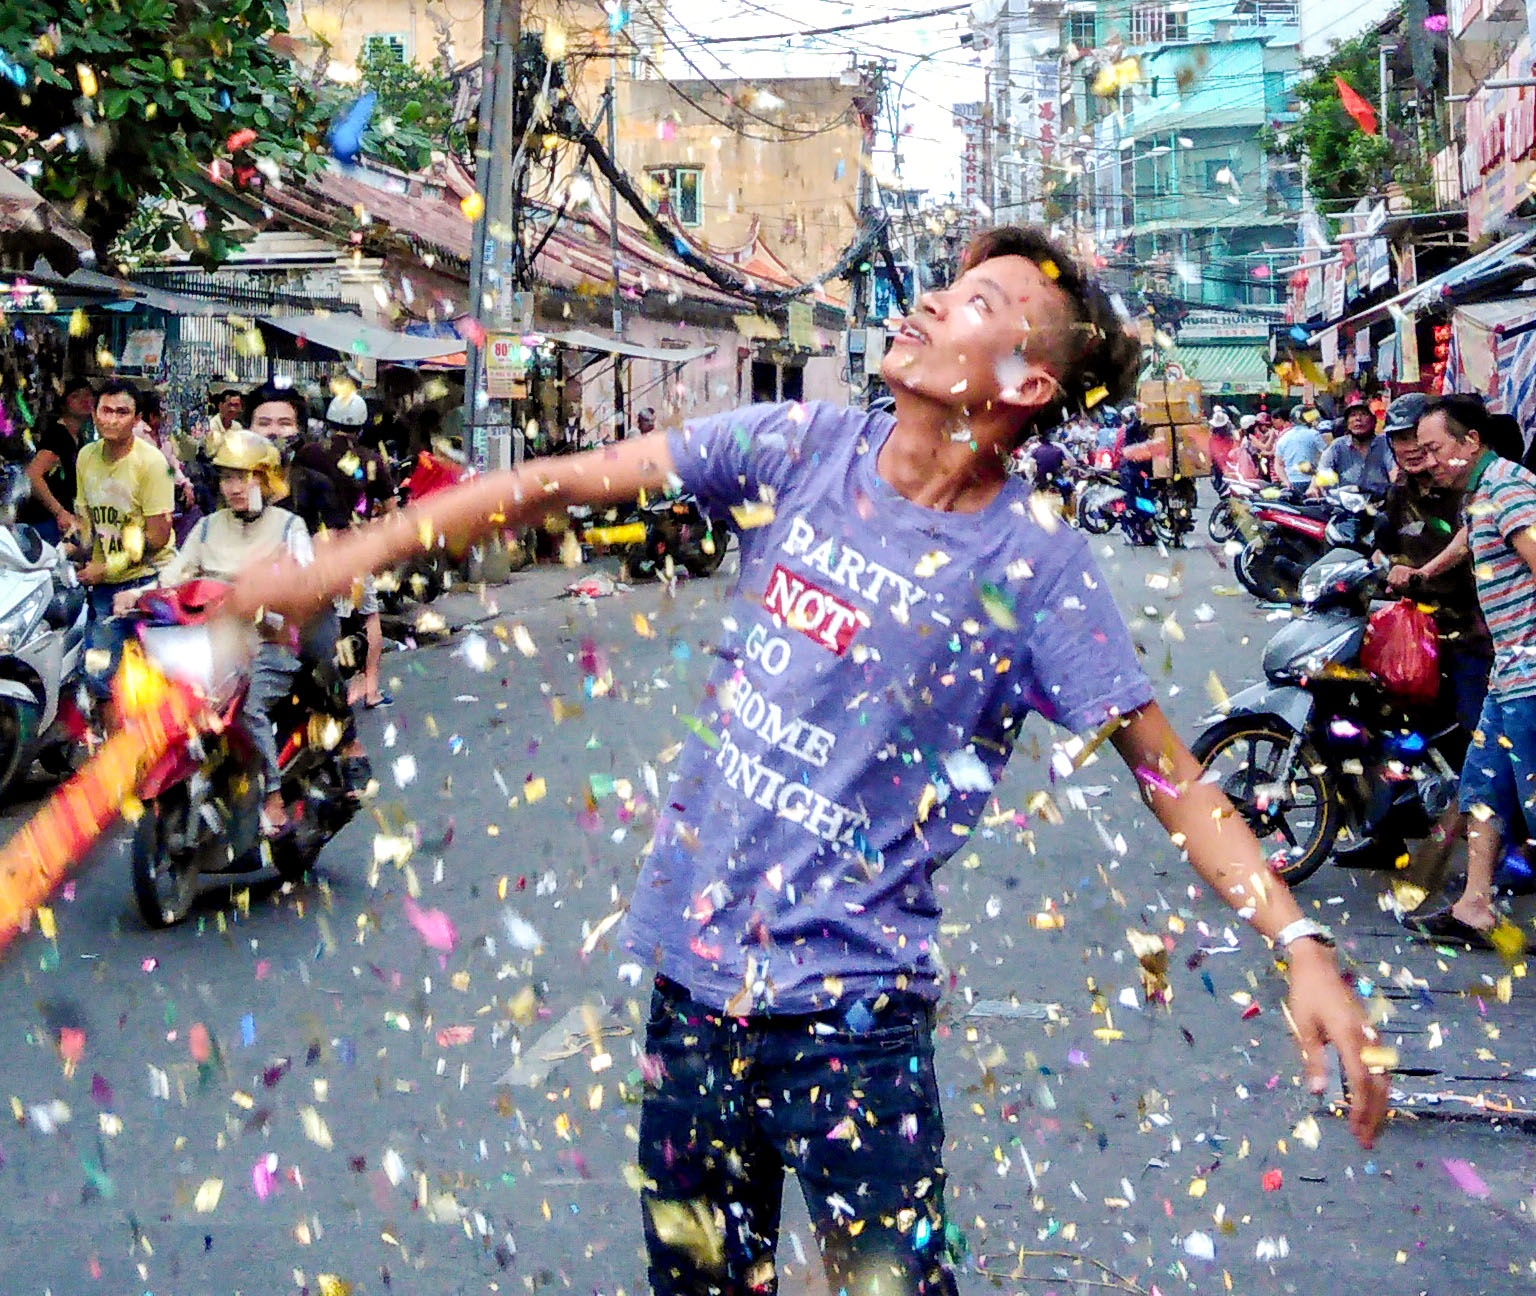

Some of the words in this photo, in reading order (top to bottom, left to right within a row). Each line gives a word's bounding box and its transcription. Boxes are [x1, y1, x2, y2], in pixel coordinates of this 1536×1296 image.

[781, 516, 928, 618] PARTY
[746, 623, 791, 676] GO
[766, 569, 856, 651] NOT
